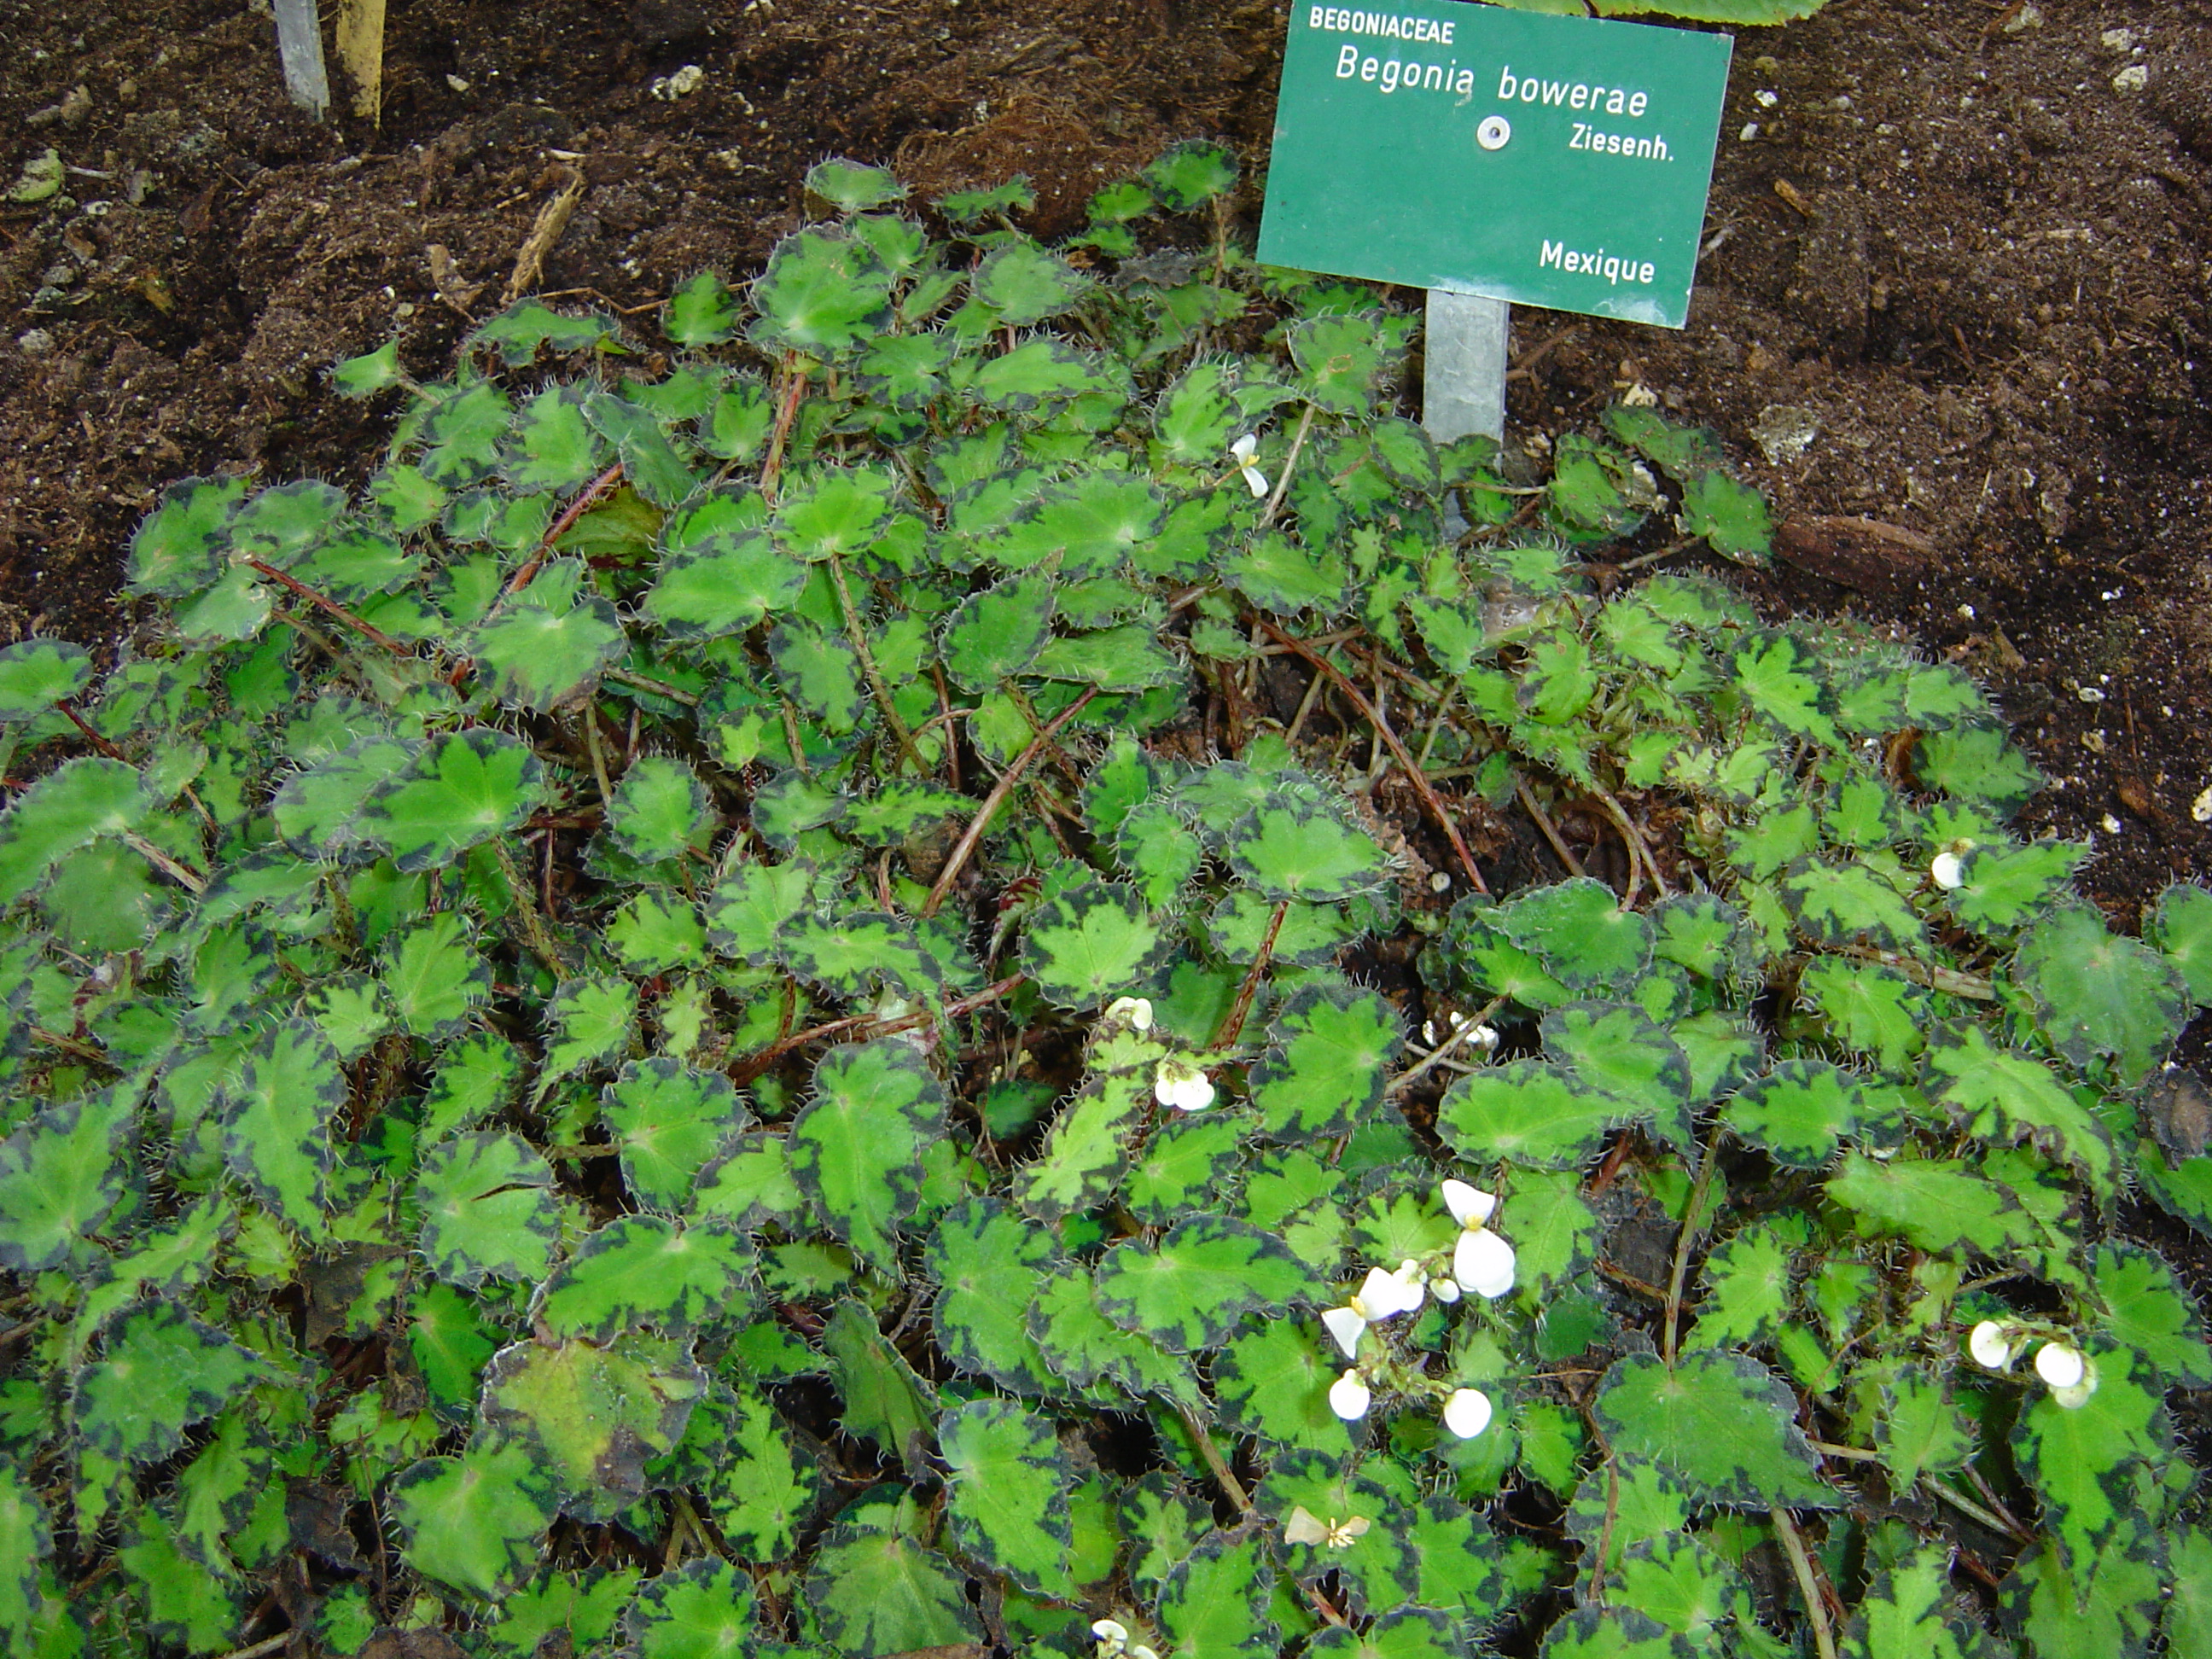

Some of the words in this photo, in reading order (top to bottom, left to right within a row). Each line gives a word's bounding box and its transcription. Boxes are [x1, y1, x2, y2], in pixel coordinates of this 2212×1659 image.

[1309, 6, 1455, 44] BEGONIACEAE
[1336, 44, 1475, 94] Begonia
[1497, 66, 1648, 117] bowerae
[1569, 123, 1674, 162] Ziesenh.
[1540, 240, 1655, 284] Mexique
